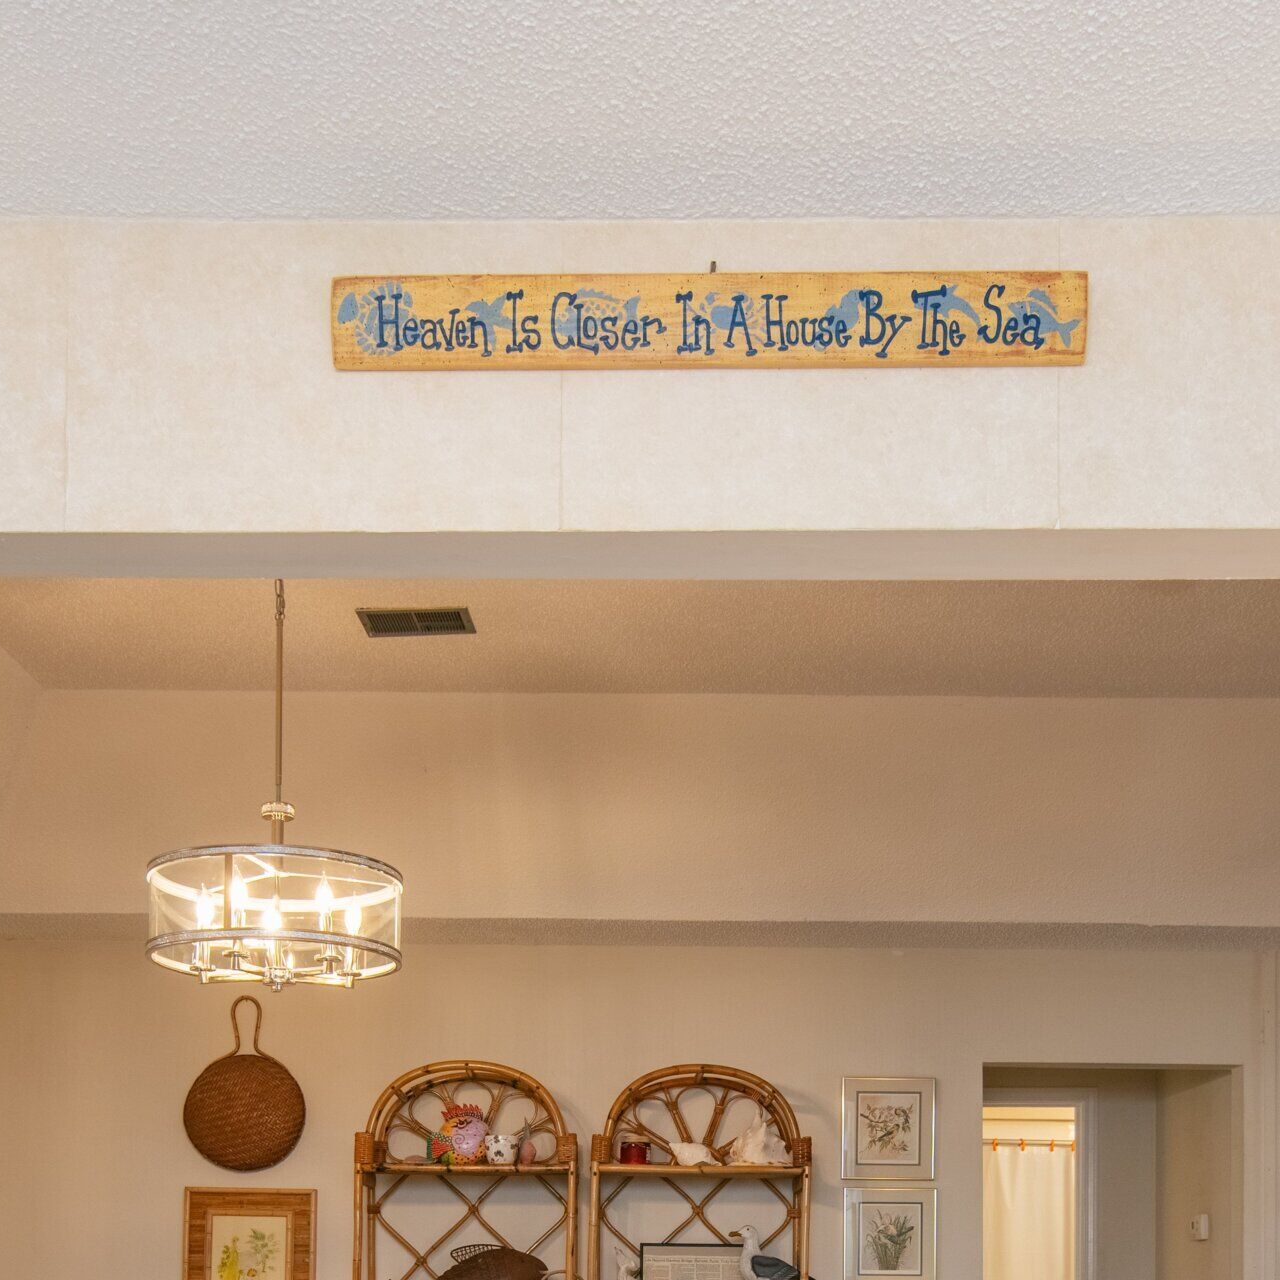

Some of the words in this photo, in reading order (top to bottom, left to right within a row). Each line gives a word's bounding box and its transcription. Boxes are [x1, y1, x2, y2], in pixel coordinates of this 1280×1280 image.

[375, 293, 492, 357] Heaven
[506, 288, 542, 354] Is
[551, 291, 667, 355] Closer
[675, 290, 714, 356] In
[723, 294, 758, 357] A
[761, 293, 852, 351] House
[859, 289, 913, 359] By
[911, 284, 967, 357] The
[977, 284, 1045, 351] Sea
